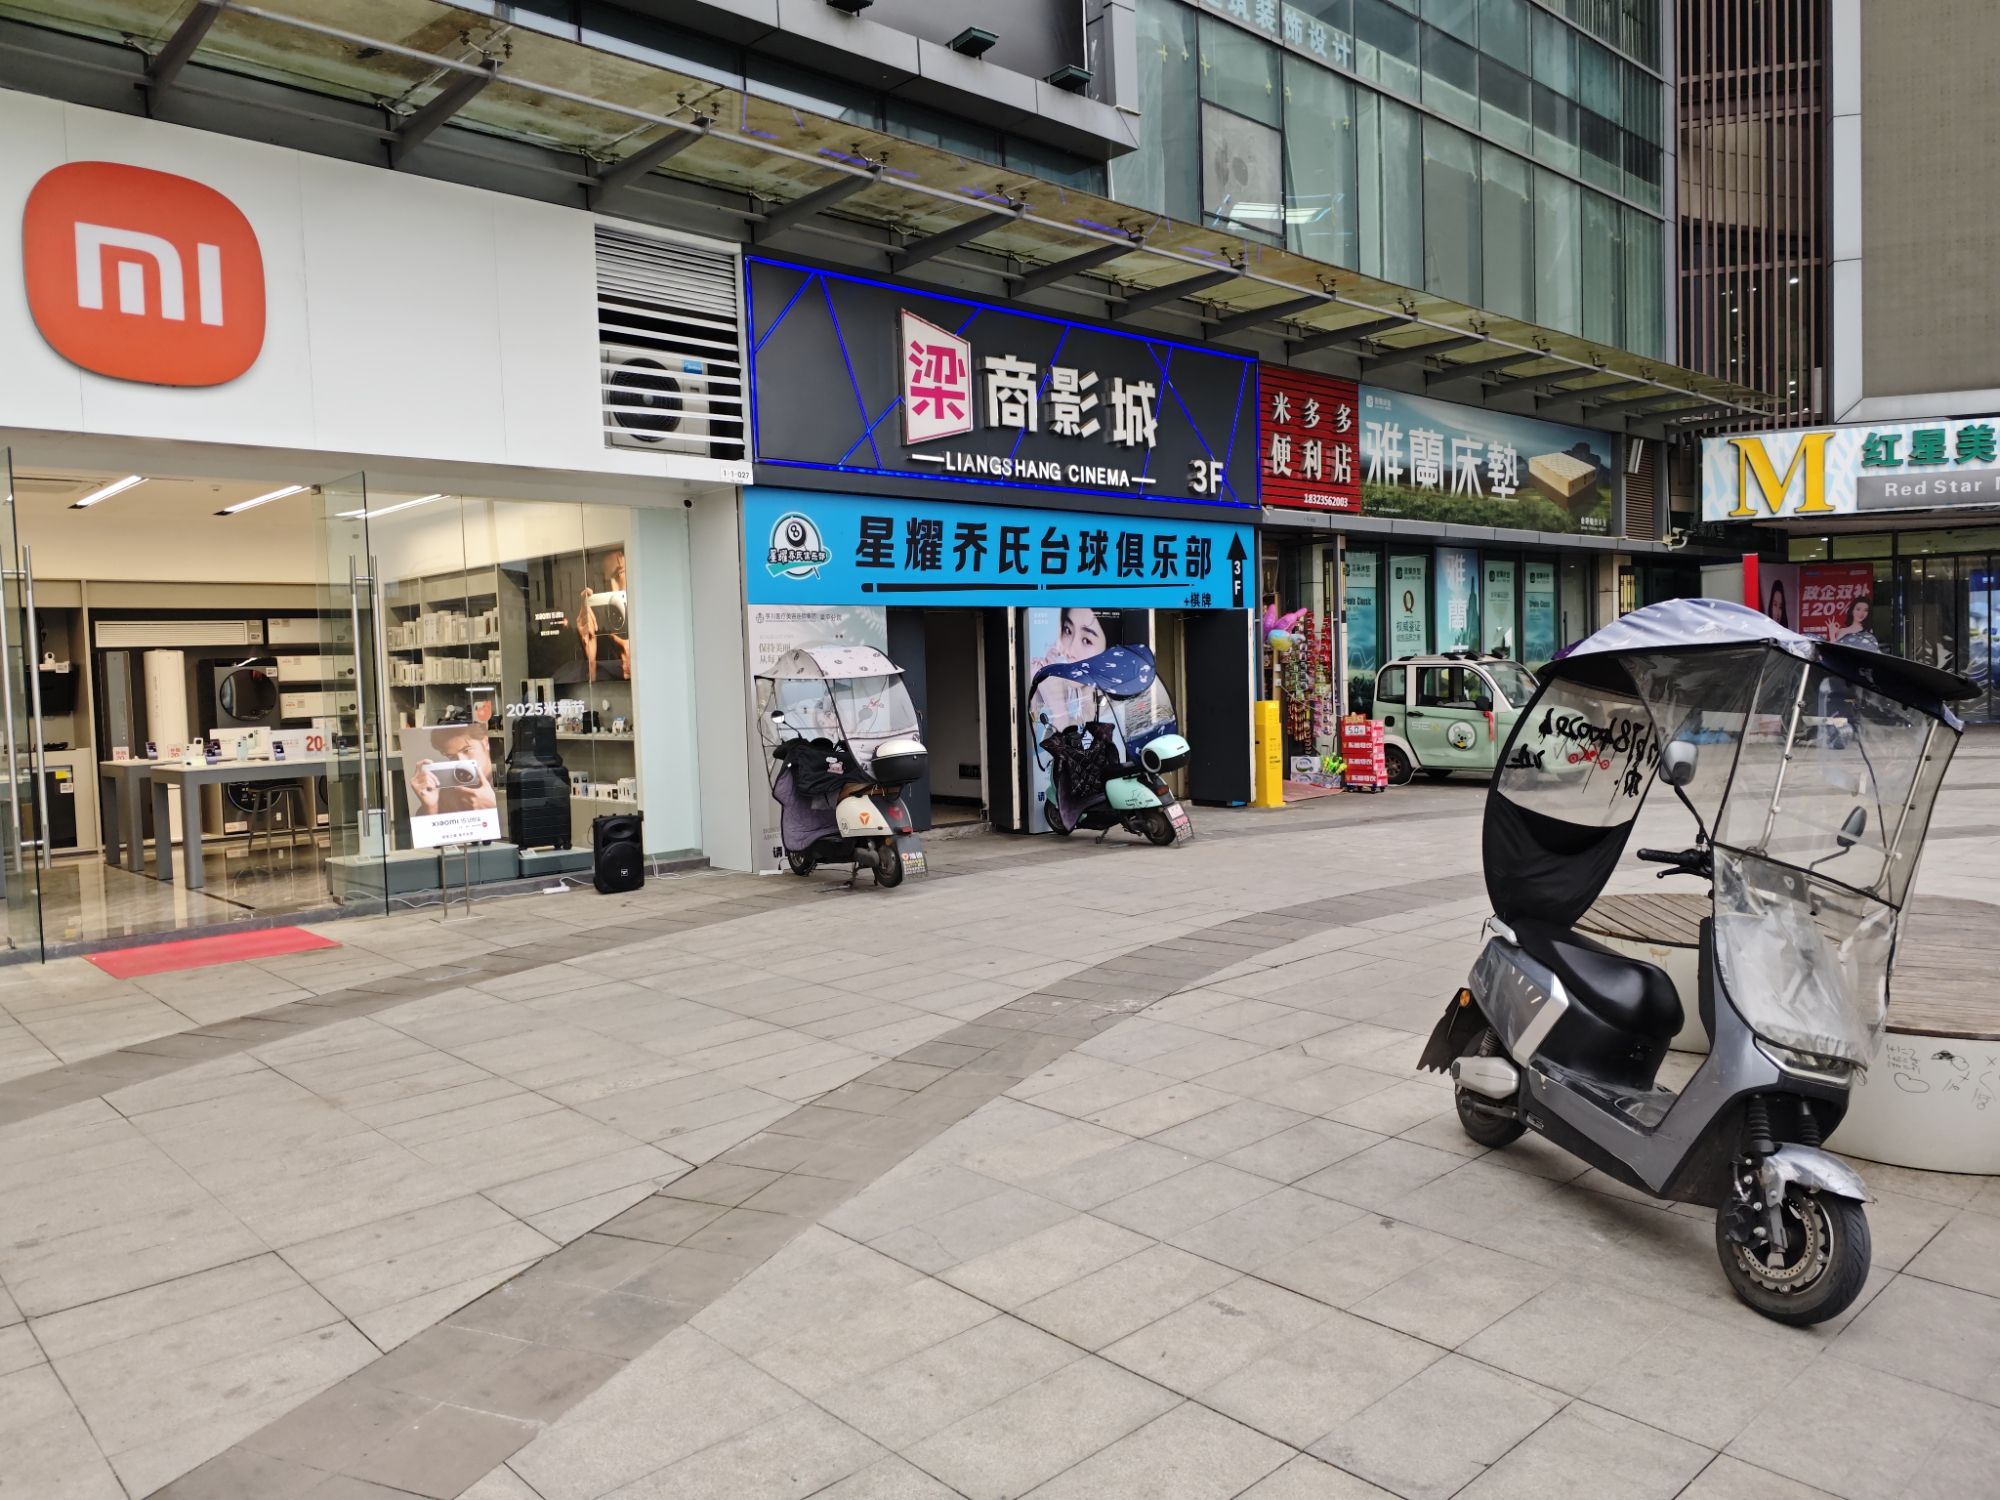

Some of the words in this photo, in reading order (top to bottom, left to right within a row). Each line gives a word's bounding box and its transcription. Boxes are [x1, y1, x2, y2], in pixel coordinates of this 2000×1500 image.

[1205, 0, 1351, 68] 筑装饰设计
[908, 340, 1159, 449] 梁商影城
[1272, 391, 1353, 434] 米多多
[945, 450, 1062, 481] LIANGSHANG
[1068, 464, 1130, 488] CINEMA
[1271, 433, 1352, 484] 便利店
[1861, 423, 1998, 469] 红星美
[1192, 459, 1224, 495] 3F
[1728, 432, 1836, 517] M
[1885, 481, 1927, 497] Red
[1934, 479, 1982, 494] Star
[1303, 493, 1349, 507] 18323562003
[854, 514, 1212, 580] 星耀乔氏台球俱乐部
